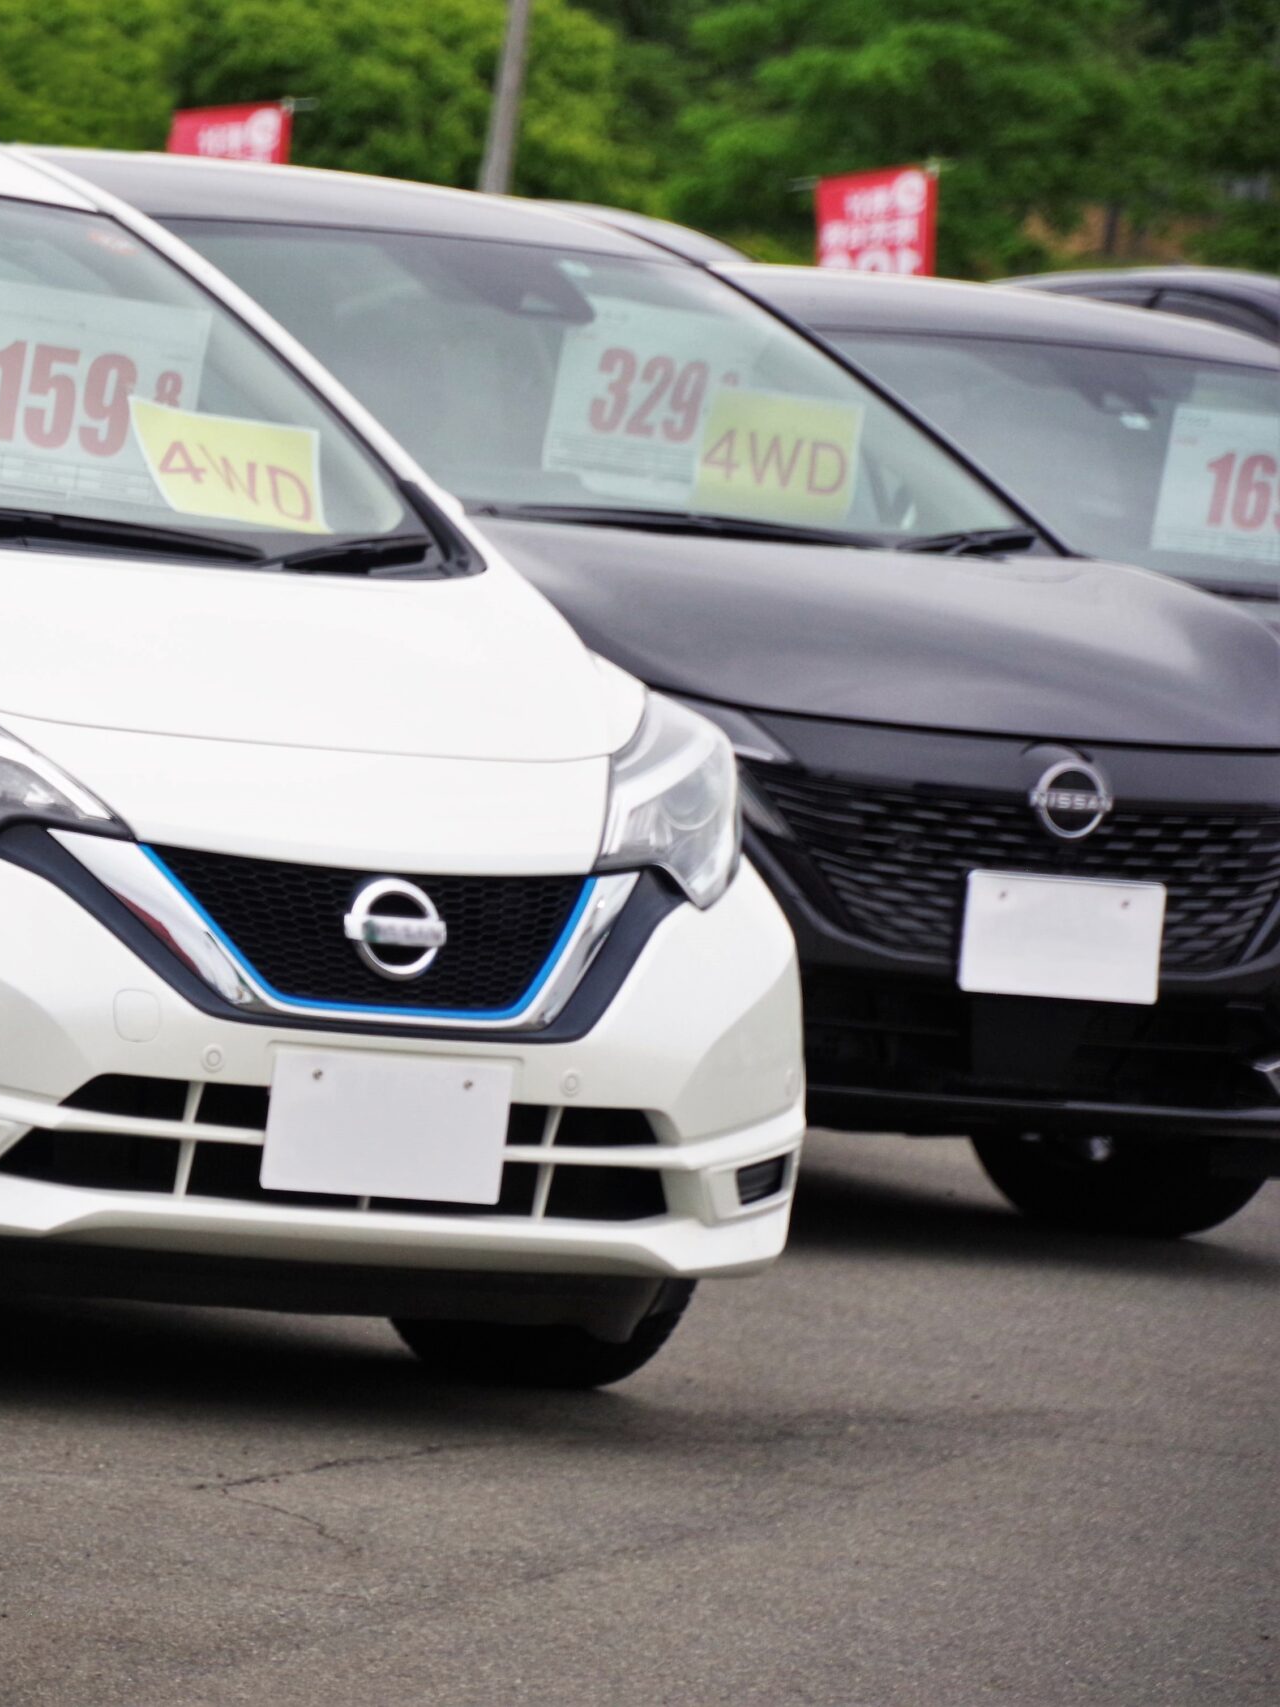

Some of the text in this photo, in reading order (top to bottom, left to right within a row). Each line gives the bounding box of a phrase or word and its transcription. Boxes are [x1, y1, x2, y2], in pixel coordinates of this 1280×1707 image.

[588, 346, 740, 443] 329
[158, 440, 313, 522] 4WD
[702, 428, 850, 497] 4WD
[1206, 450, 1280, 531] 16
